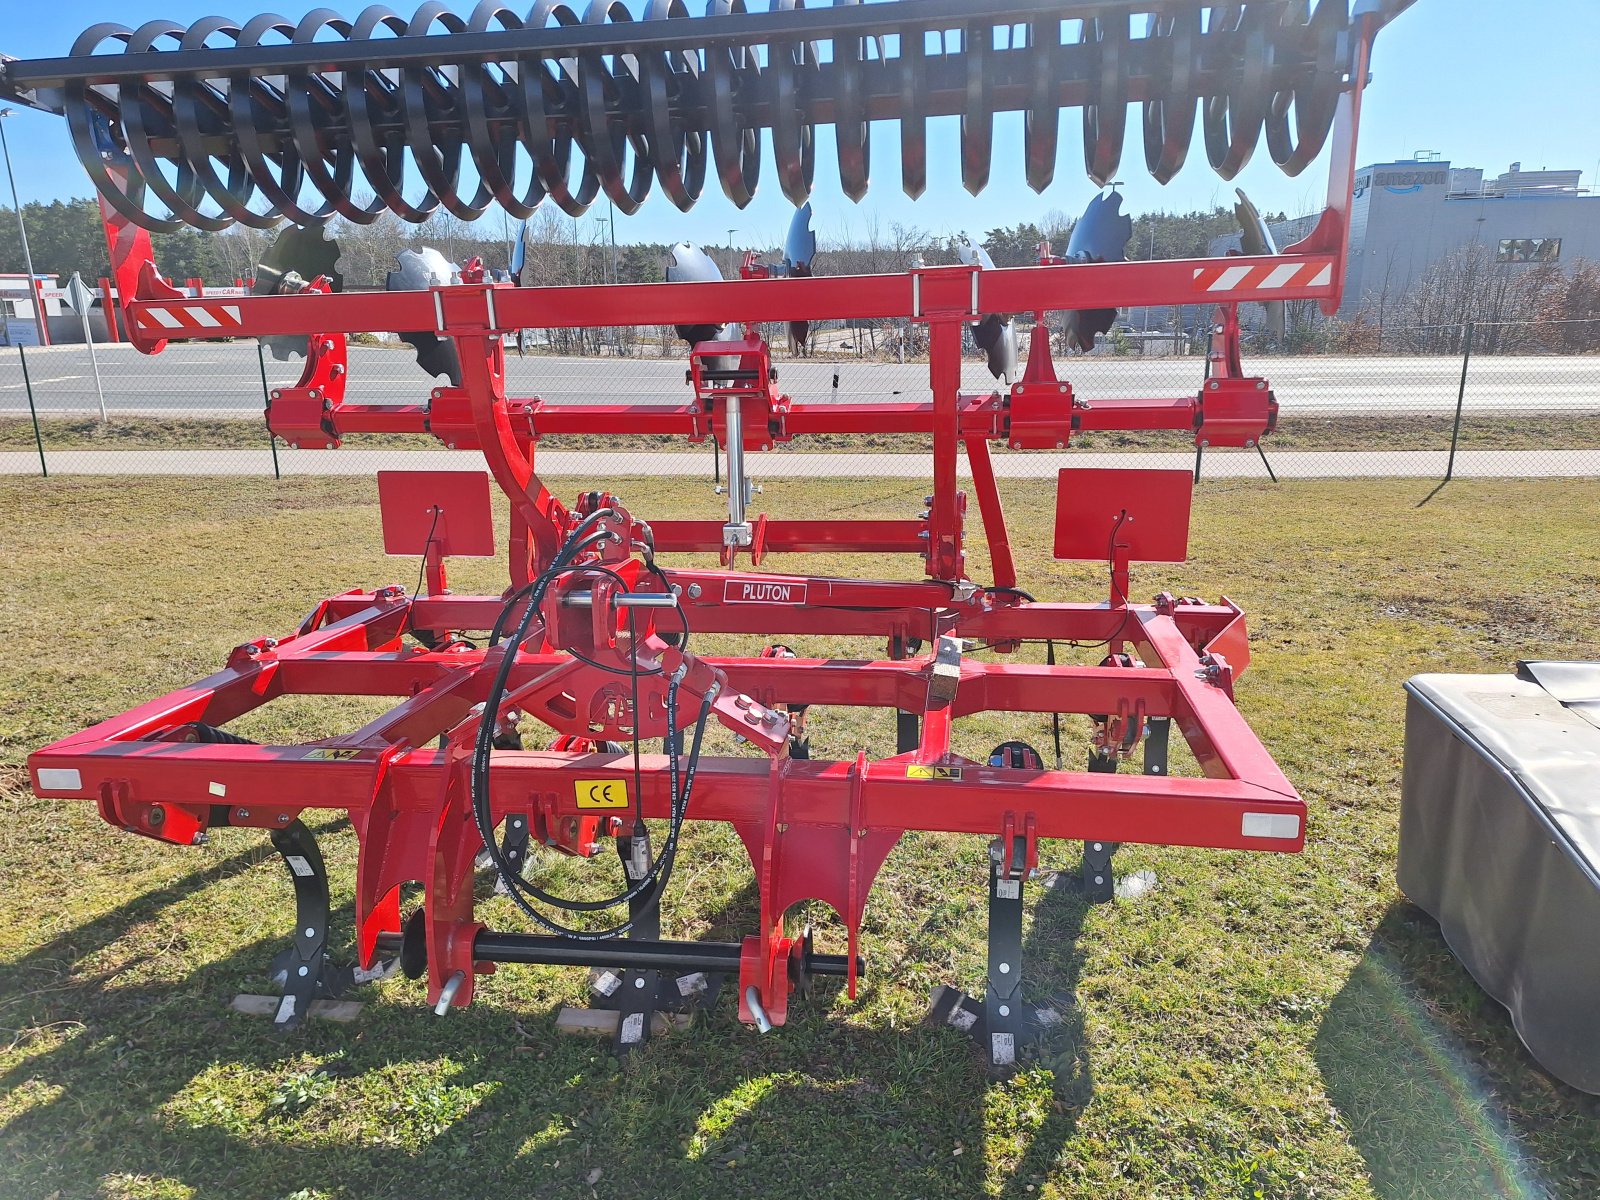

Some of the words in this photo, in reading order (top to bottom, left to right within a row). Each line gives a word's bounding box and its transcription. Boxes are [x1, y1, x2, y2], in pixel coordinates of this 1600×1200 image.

[1374, 171, 1447, 186] amazon
[742, 584, 791, 600] PLUTON
[590, 785, 613, 802] CE
